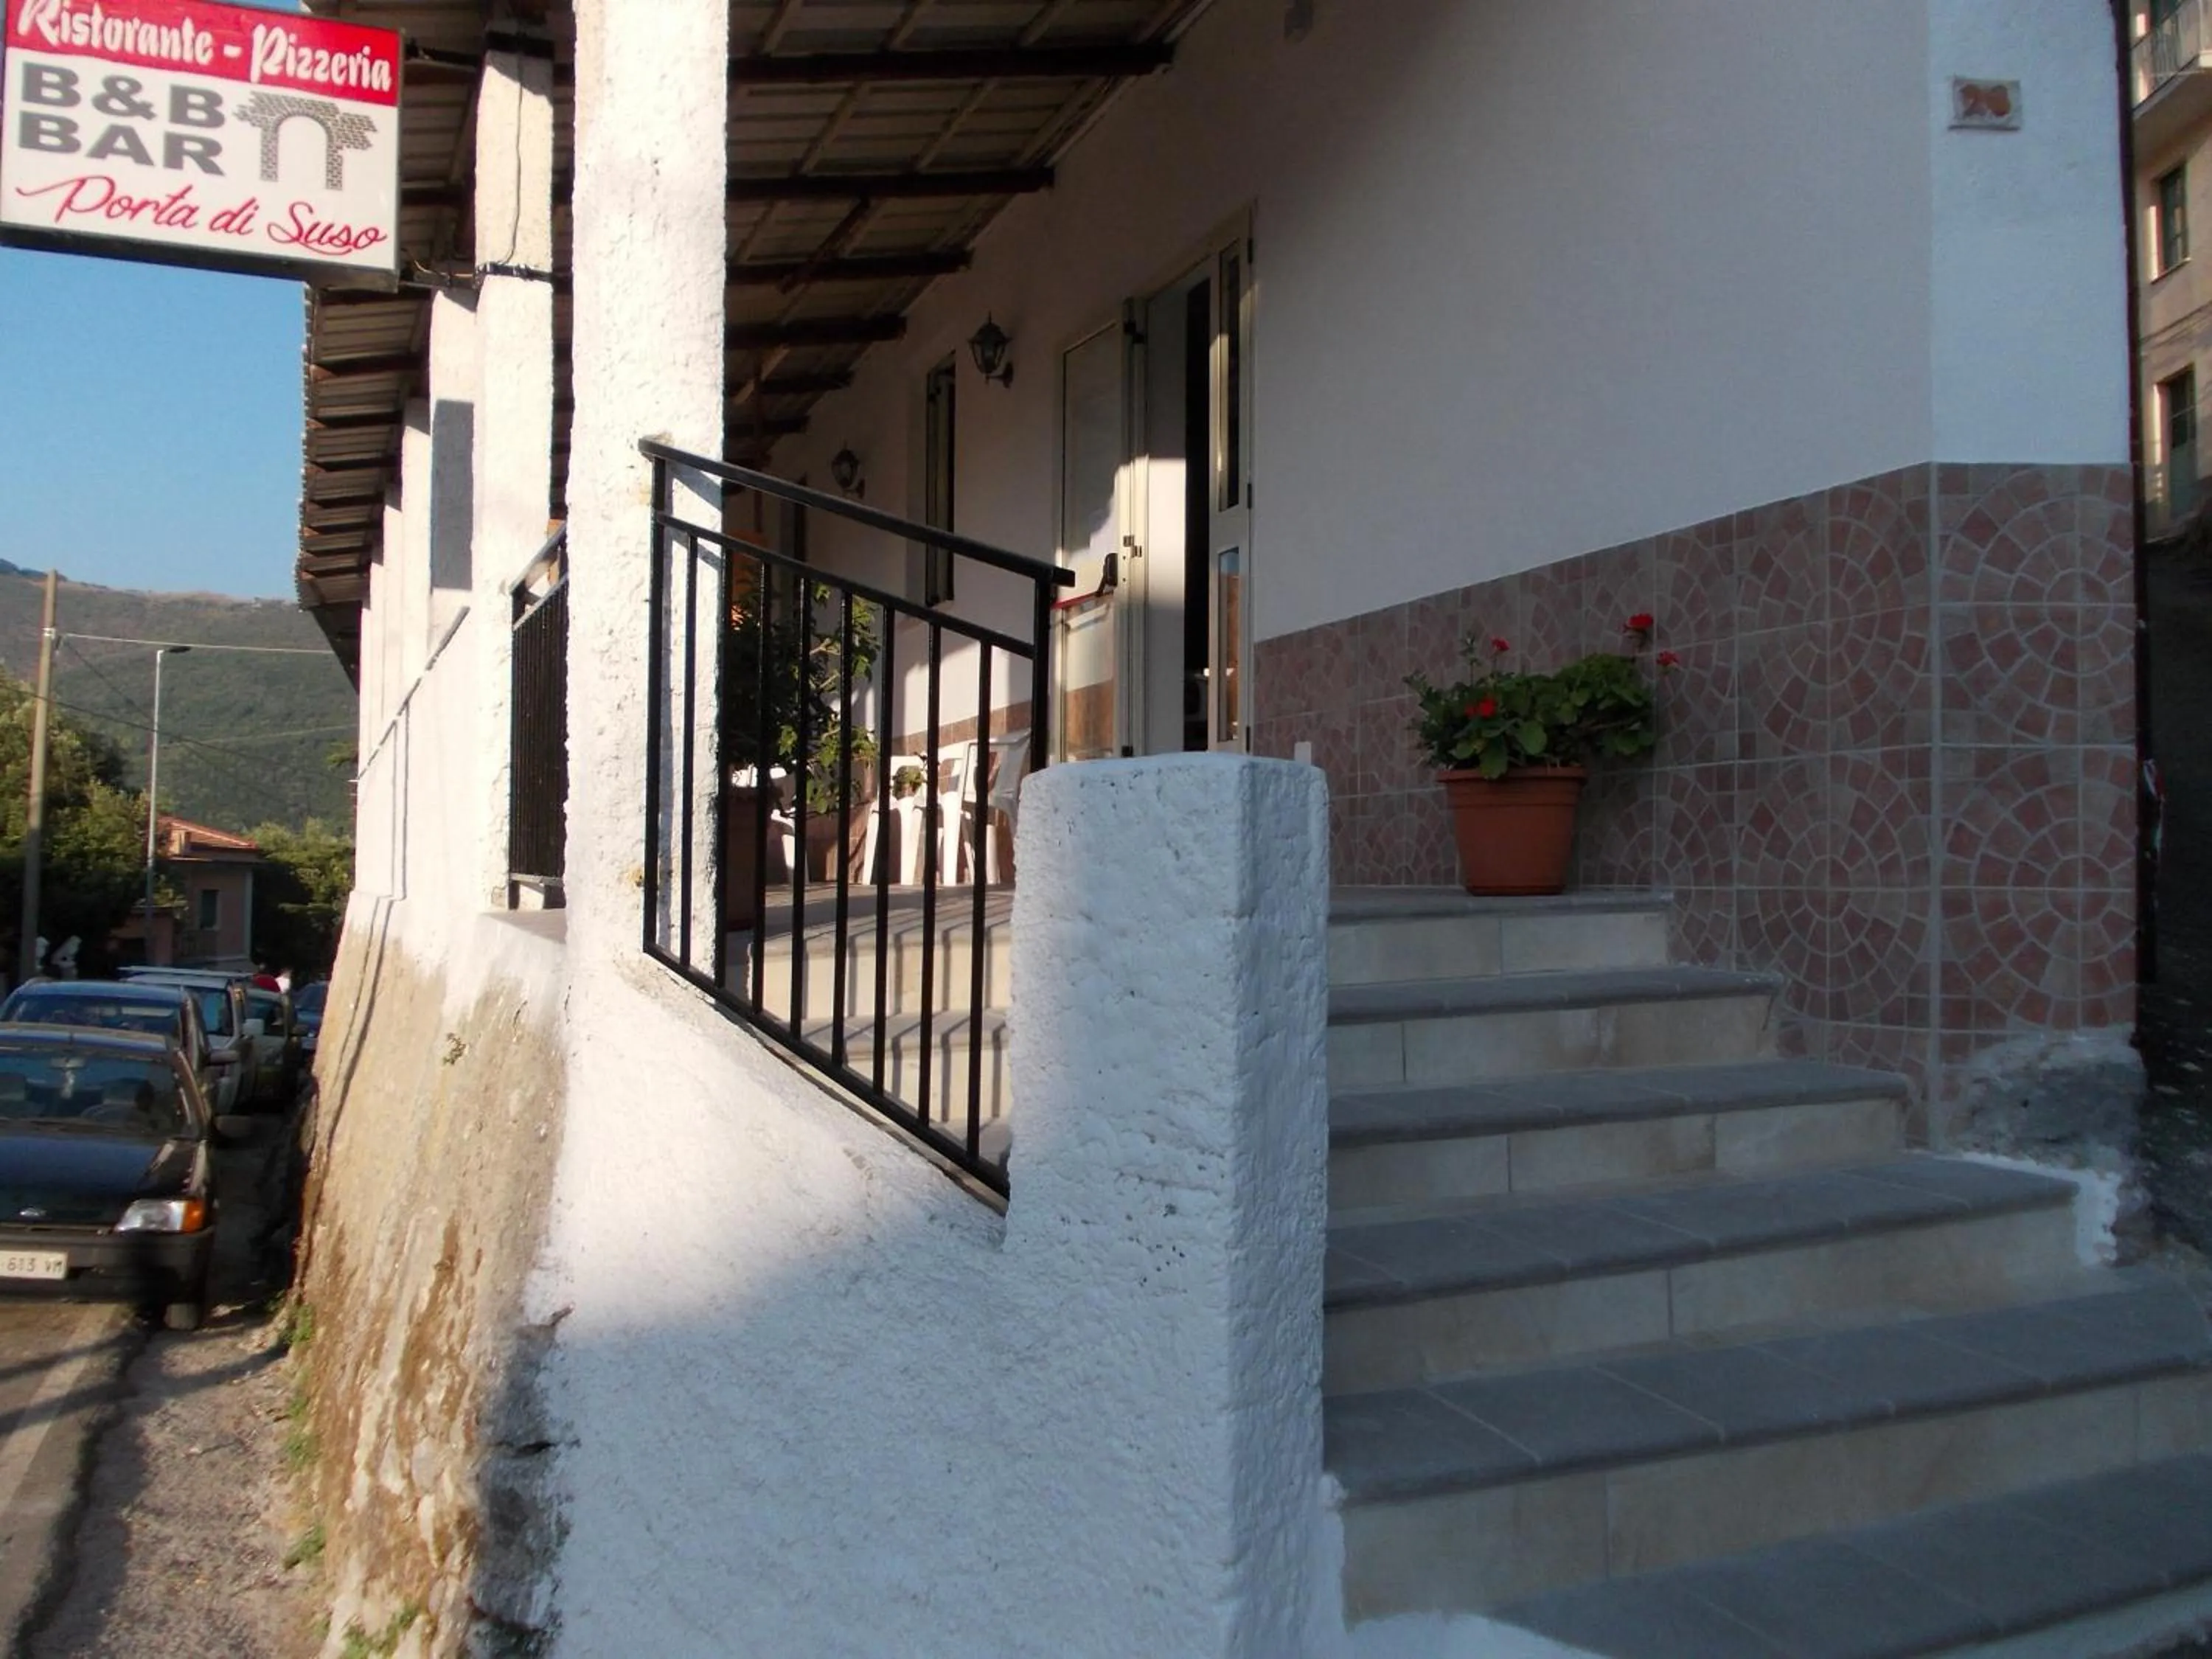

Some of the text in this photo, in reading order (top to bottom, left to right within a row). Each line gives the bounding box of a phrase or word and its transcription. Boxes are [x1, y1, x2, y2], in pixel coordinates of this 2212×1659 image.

[17, 0, 214, 66] Ristorante
[250, 23, 392, 91] Pizzeria
[21, 62, 225, 128] B&B
[18, 111, 225, 176] BAR
[15, 175, 387, 256] Porta di Suso
